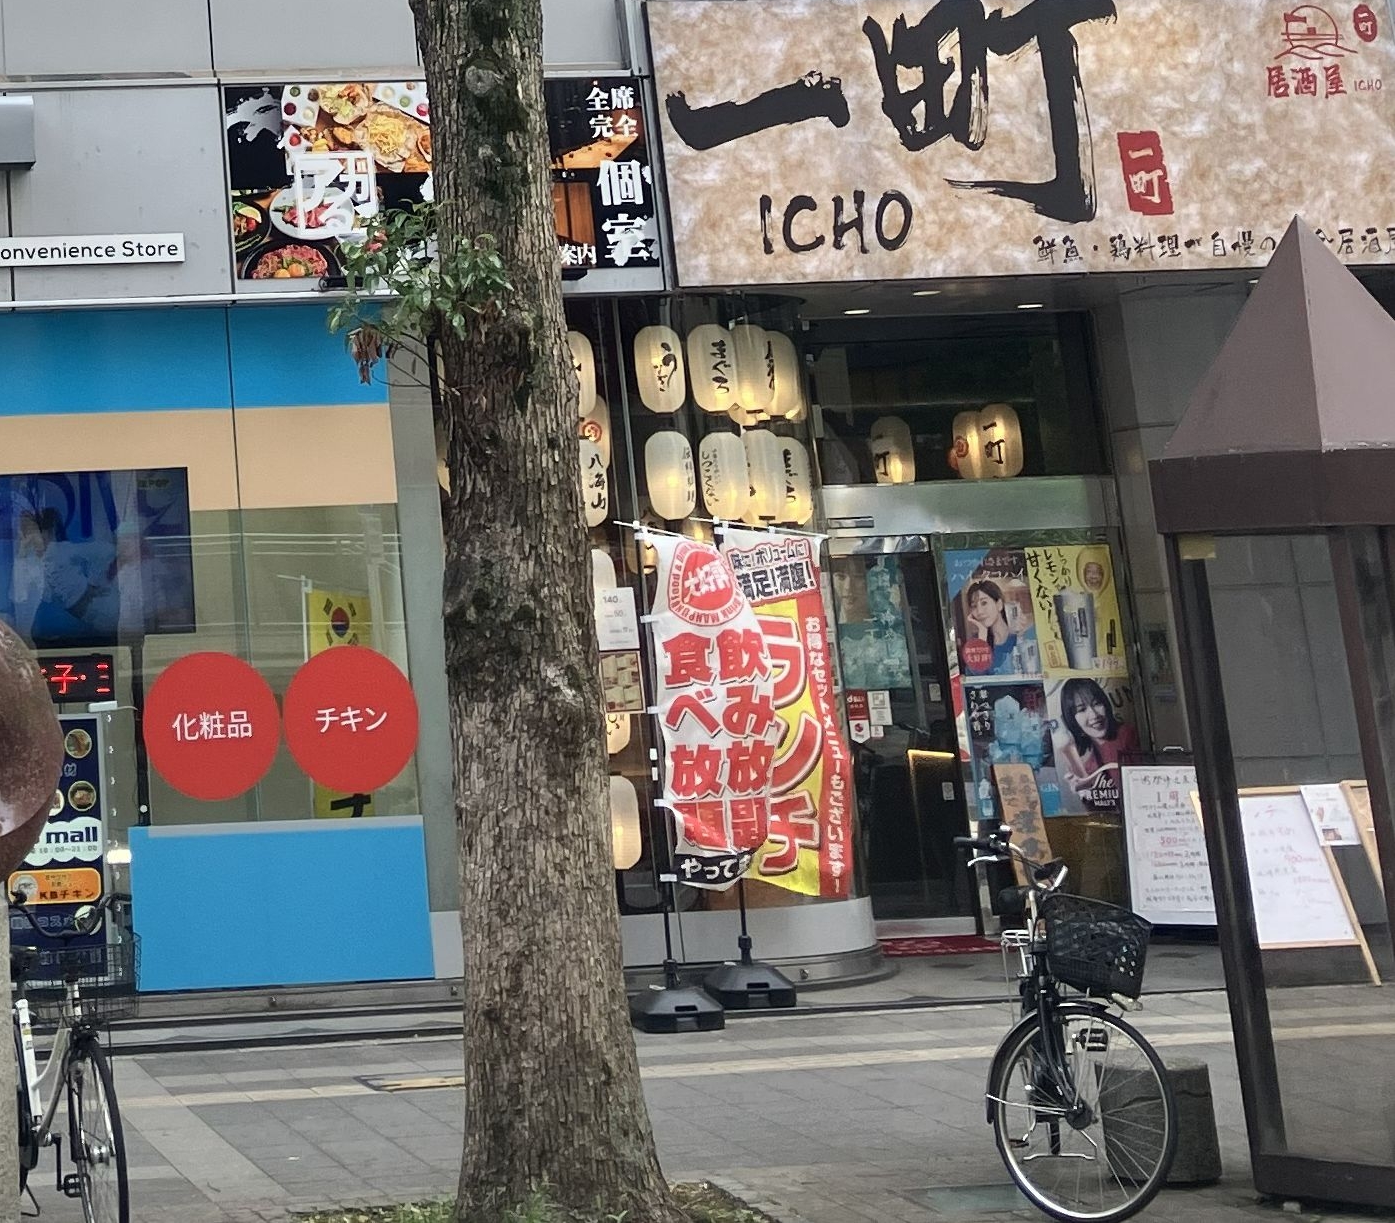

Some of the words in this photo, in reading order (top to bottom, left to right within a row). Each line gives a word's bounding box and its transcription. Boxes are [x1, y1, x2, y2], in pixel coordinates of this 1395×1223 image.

[1266, 64, 1347, 98] 居酒屋
[1354, 79, 1382, 91] ICHO
[585, 86, 634, 111] 全席
[589, 114, 638, 139] 完全
[1126, 147, 1168, 204] 一町
[758, 188, 914, 256] ICHO
[121, 240, 179, 258] Store
[589, 452, 607, 510] 八海山
[172, 710, 253, 742] 化粧品
[315, 706, 388, 733] チキン
[46, 826, 97, 844] mall
